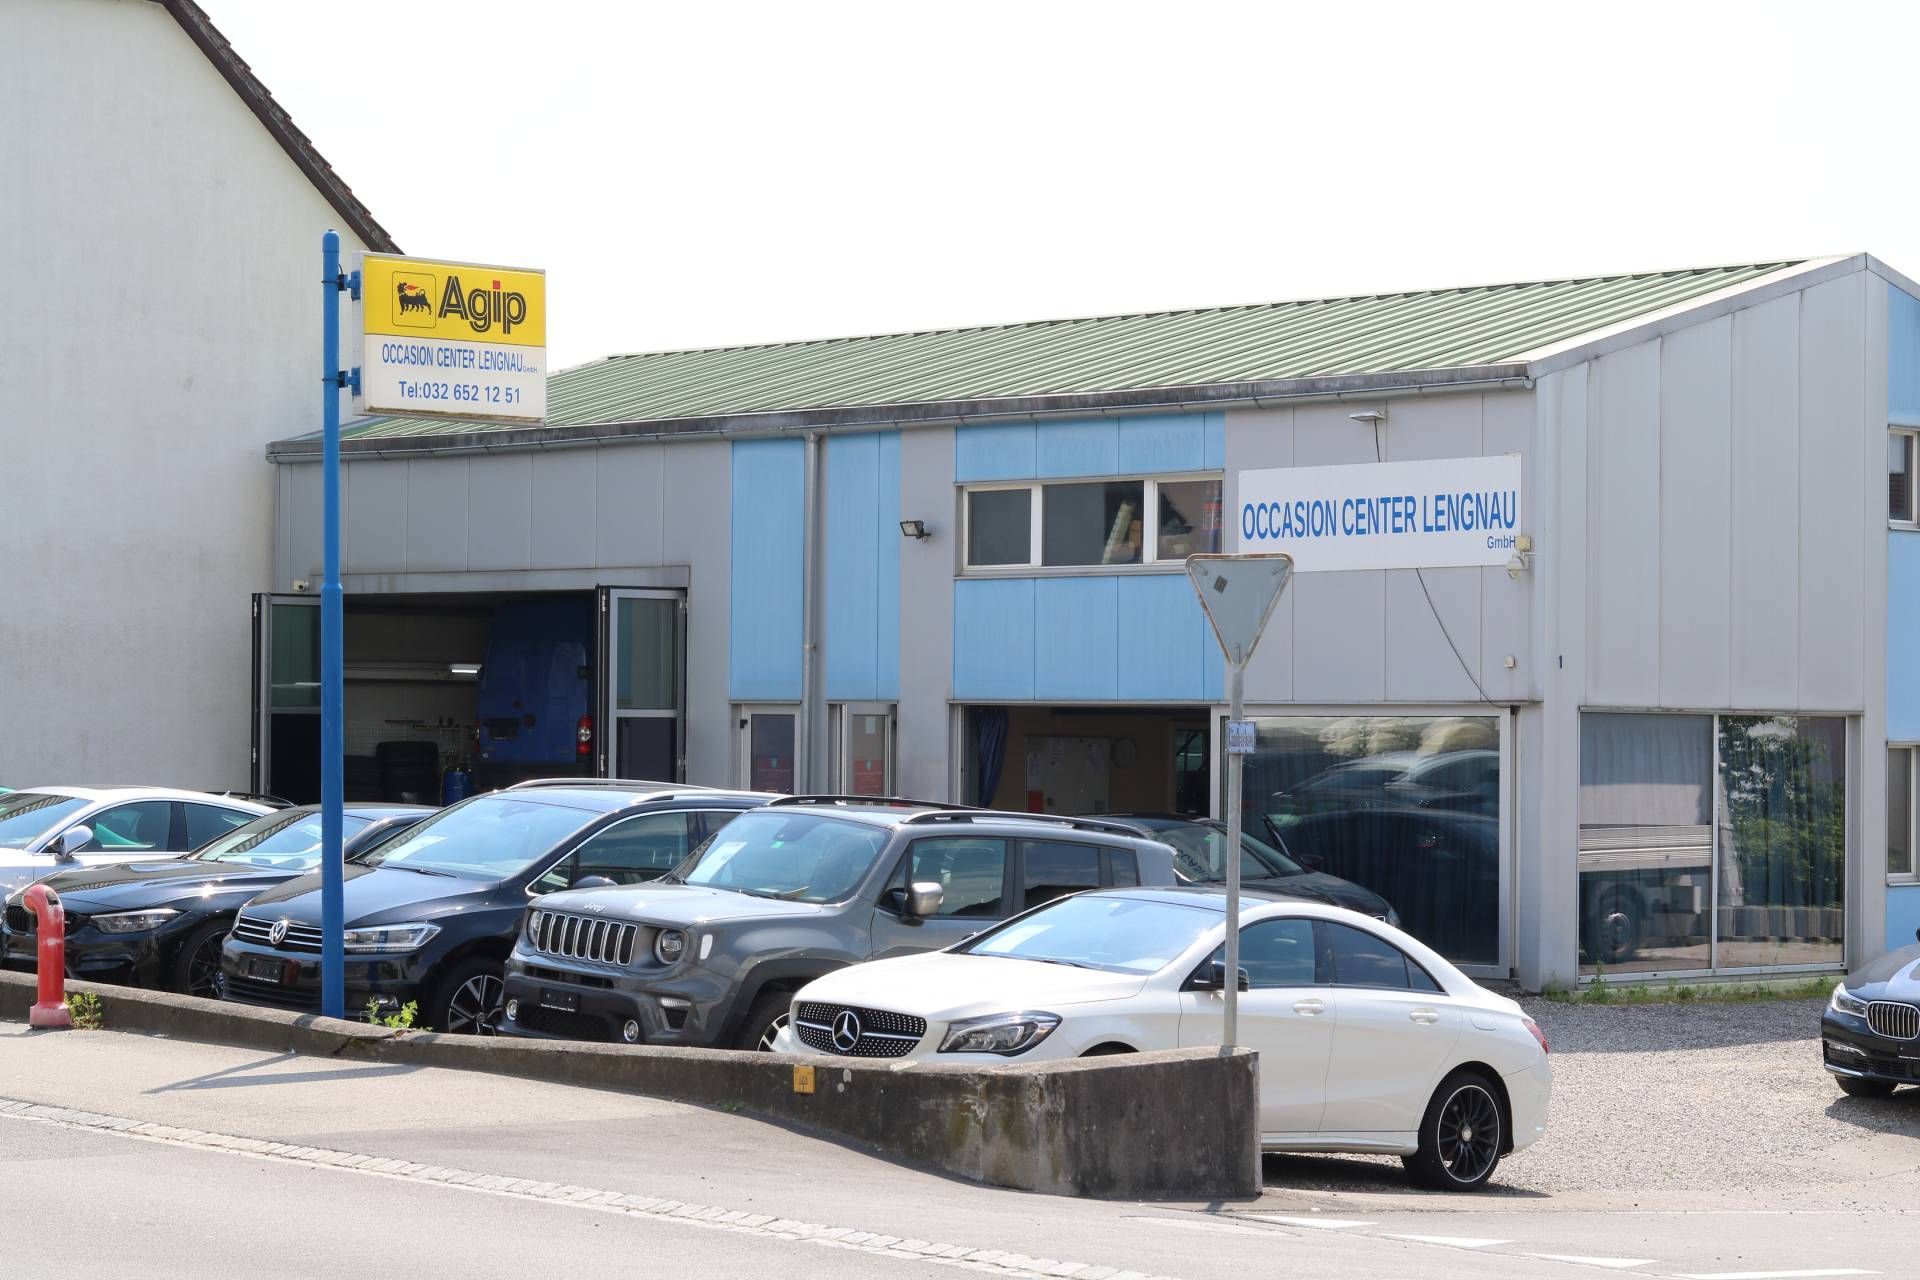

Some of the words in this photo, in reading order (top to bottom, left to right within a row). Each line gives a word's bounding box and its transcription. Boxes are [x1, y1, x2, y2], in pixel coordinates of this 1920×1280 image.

[438, 275, 527, 334] Agip
[382, 343, 433, 366] OCCASION
[437, 347, 475, 369] CENTER
[479, 351, 523, 373] LENGNAU
[399, 381, 449, 400] Tel:032
[454, 384, 479, 401] 652
[485, 386, 500, 403] 12
[505, 387, 520, 404] 51
[1242, 500, 1337, 540] OCCASION
[1342, 495, 1417, 536] CENTER
[1423, 490, 1516, 532] LENGNAU
[1487, 535, 1516, 549] GmbH
